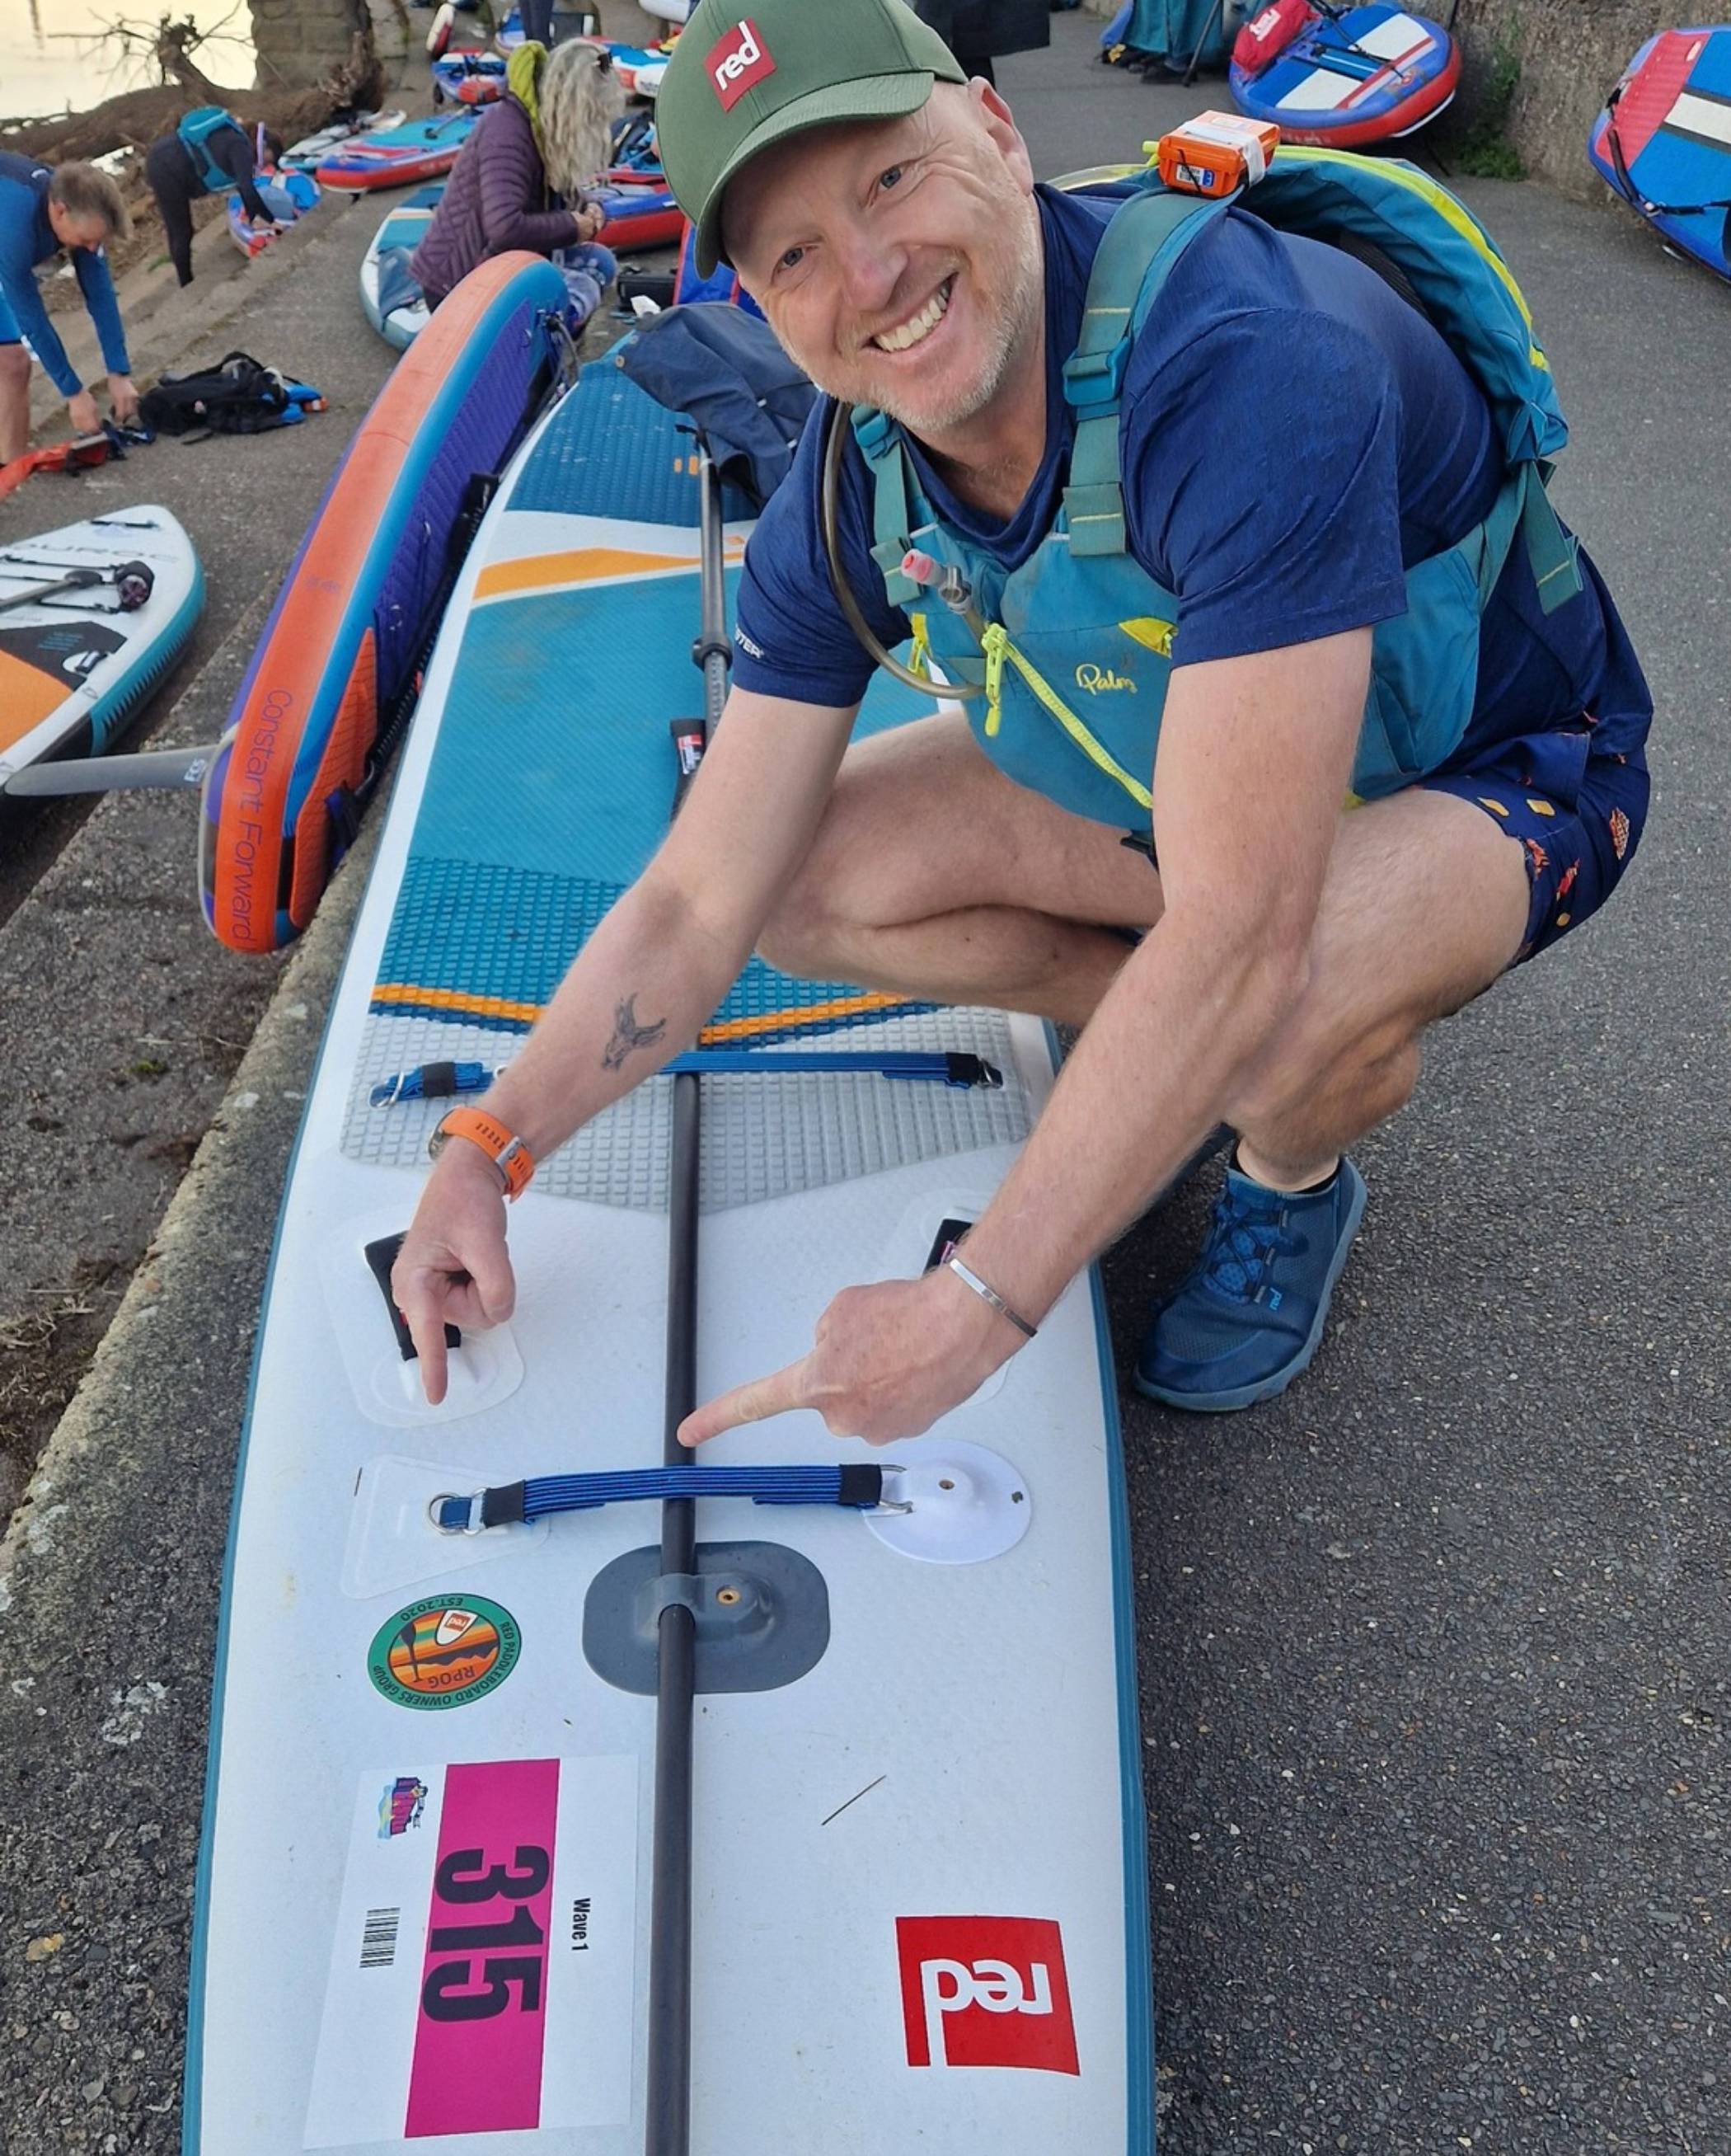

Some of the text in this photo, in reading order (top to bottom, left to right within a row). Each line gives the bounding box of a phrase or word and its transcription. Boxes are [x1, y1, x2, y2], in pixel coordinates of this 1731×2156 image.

[715, 21, 761, 92] red
[1076, 664, 1138, 695] Palm
[232, 689, 292, 942] Constant Forward
[373, 1621, 516, 1706] RED PADDLEBOARD OWNERS GROUP
[428, 1665, 476, 1689] RPOG
[422, 1845, 550, 2022] 315
[571, 1898, 591, 1951] Wave 1
[919, 1958, 1053, 2067] red
